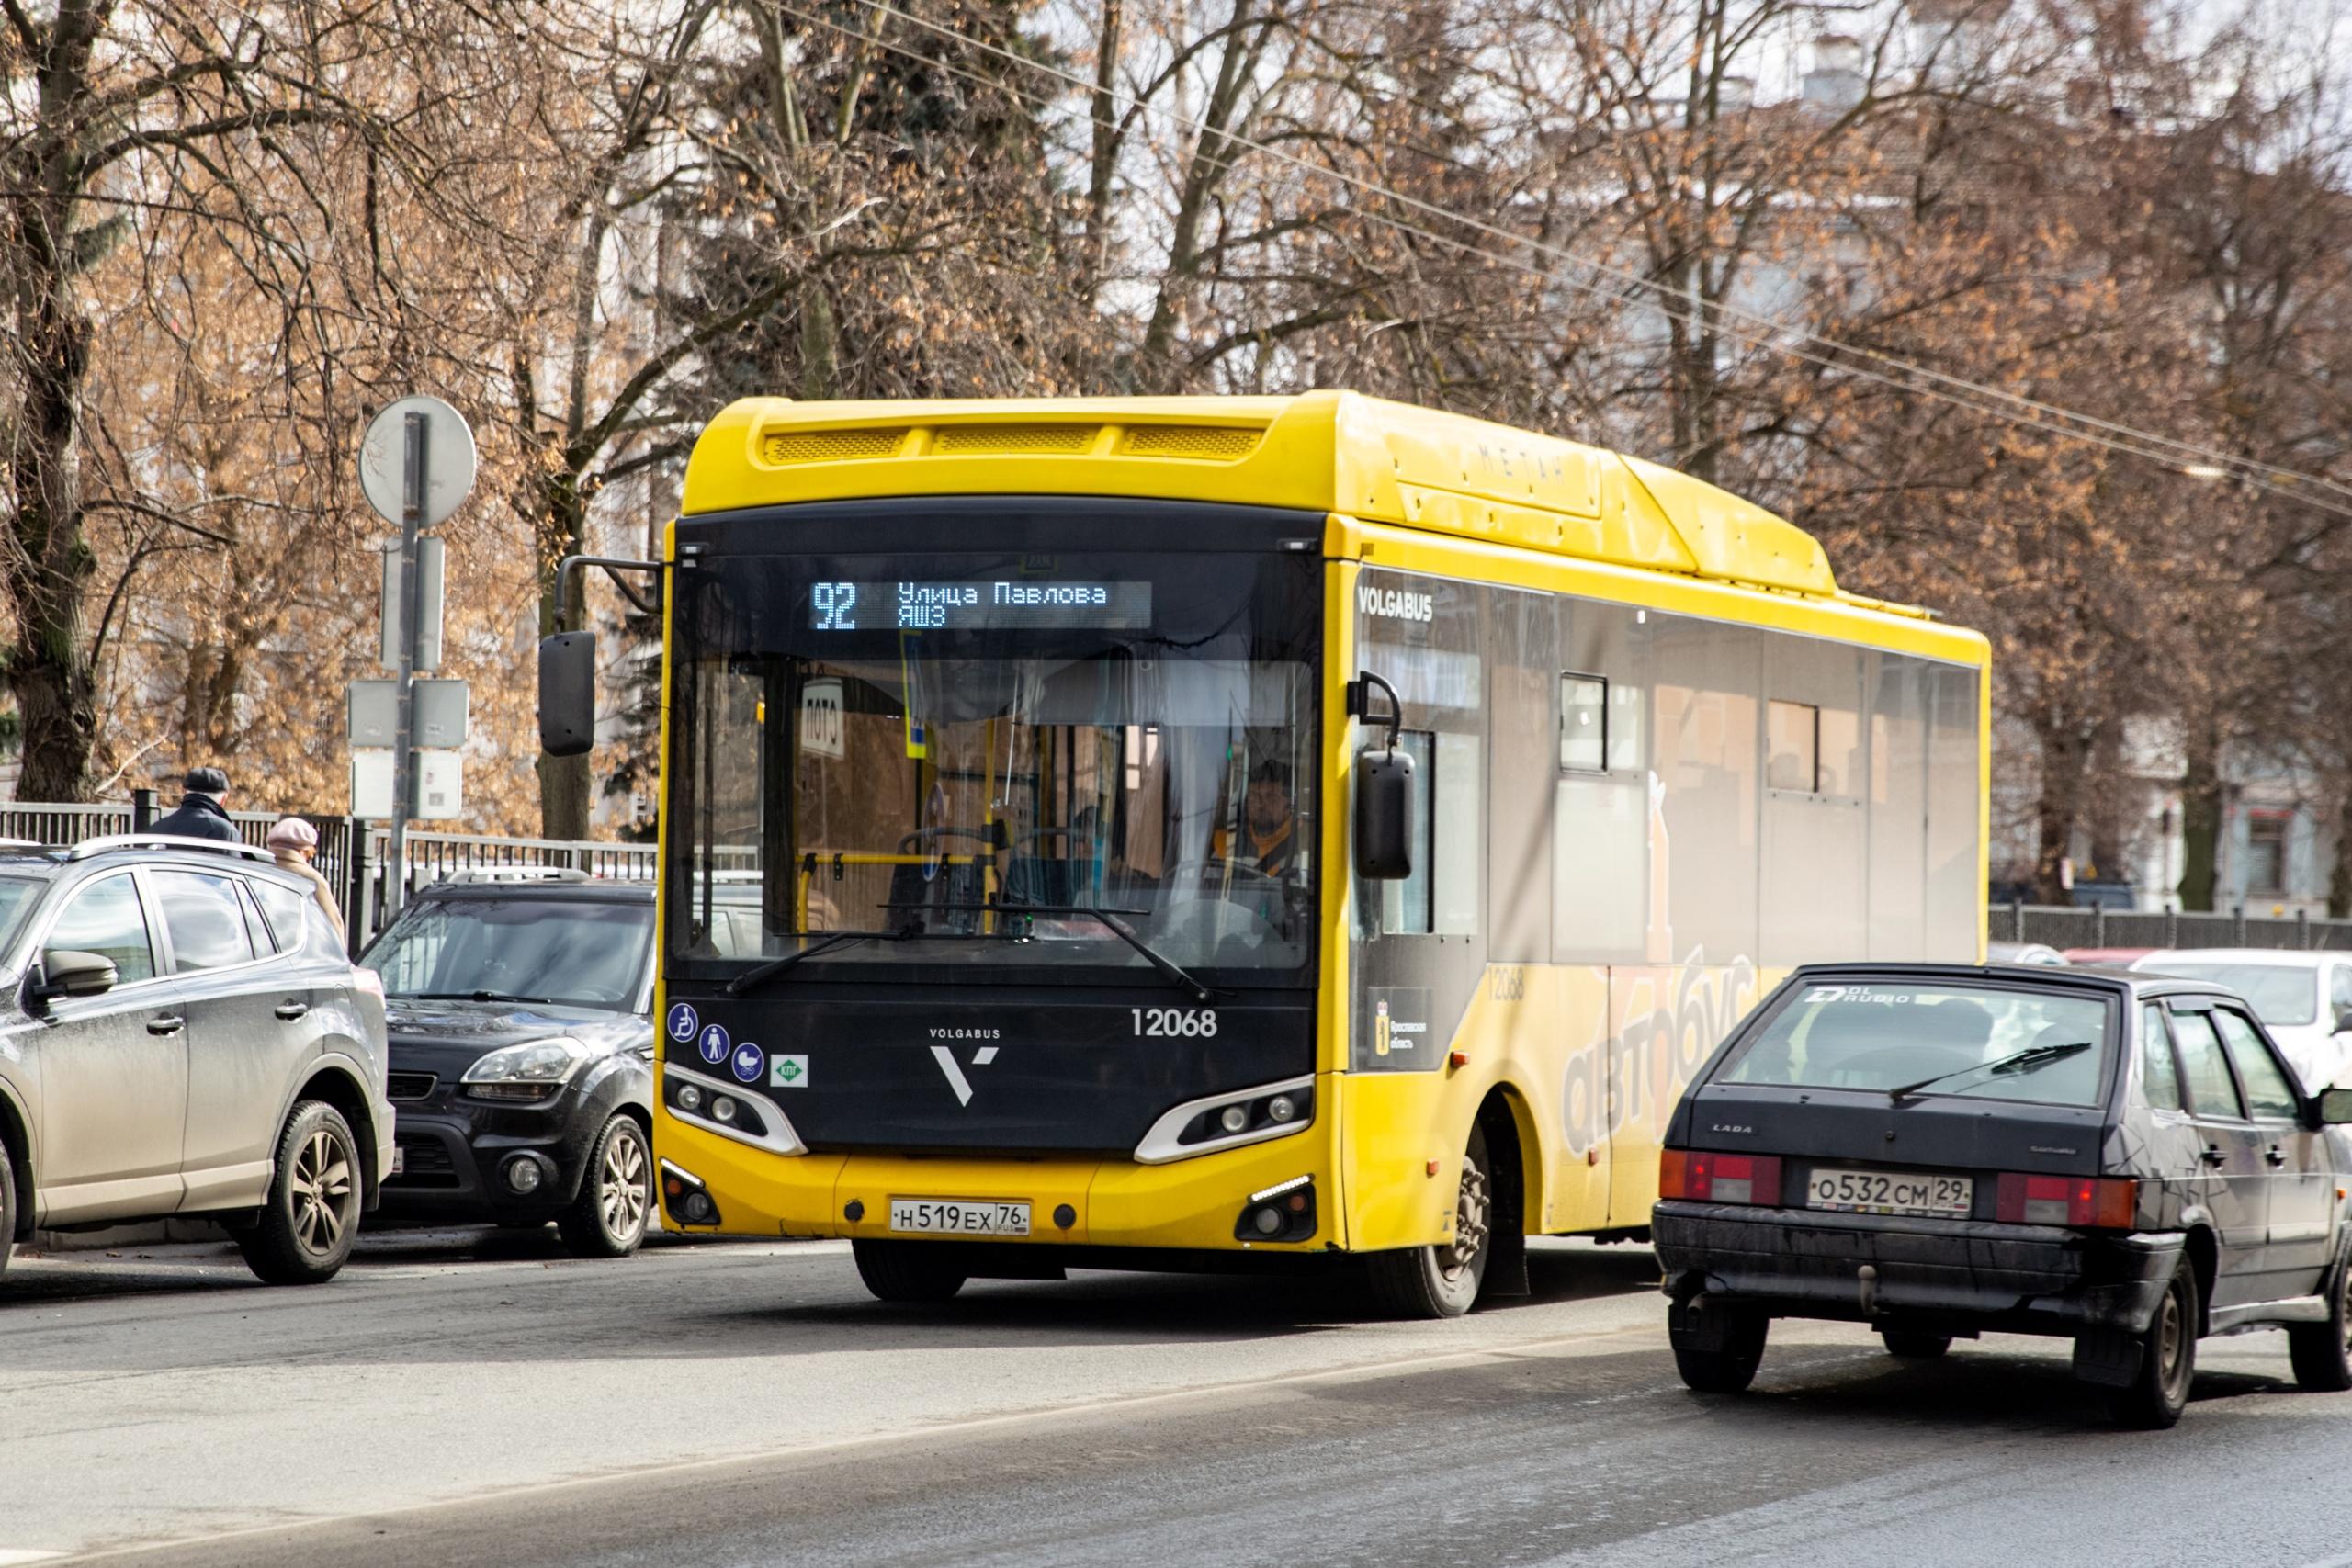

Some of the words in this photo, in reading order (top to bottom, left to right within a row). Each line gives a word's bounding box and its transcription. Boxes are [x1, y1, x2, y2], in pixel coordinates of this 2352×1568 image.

[898, 581, 978, 606] Улица
[994, 581, 1107, 604] Павлова
[1358, 586, 1433, 622] VOLGABUS
[813, 582, 856, 630] 92
[898, 605, 946, 627] ЯШЗ
[1487, 966, 1525, 1001] 12068
[930, 1028, 1001, 1040] VOLGABUS
[1131, 1008, 1217, 1038] 12068
[1713, 1123, 1753, 1134] LADA
[1936, 1179, 1963, 1201] 29
[999, 1206, 1022, 1224] 76
